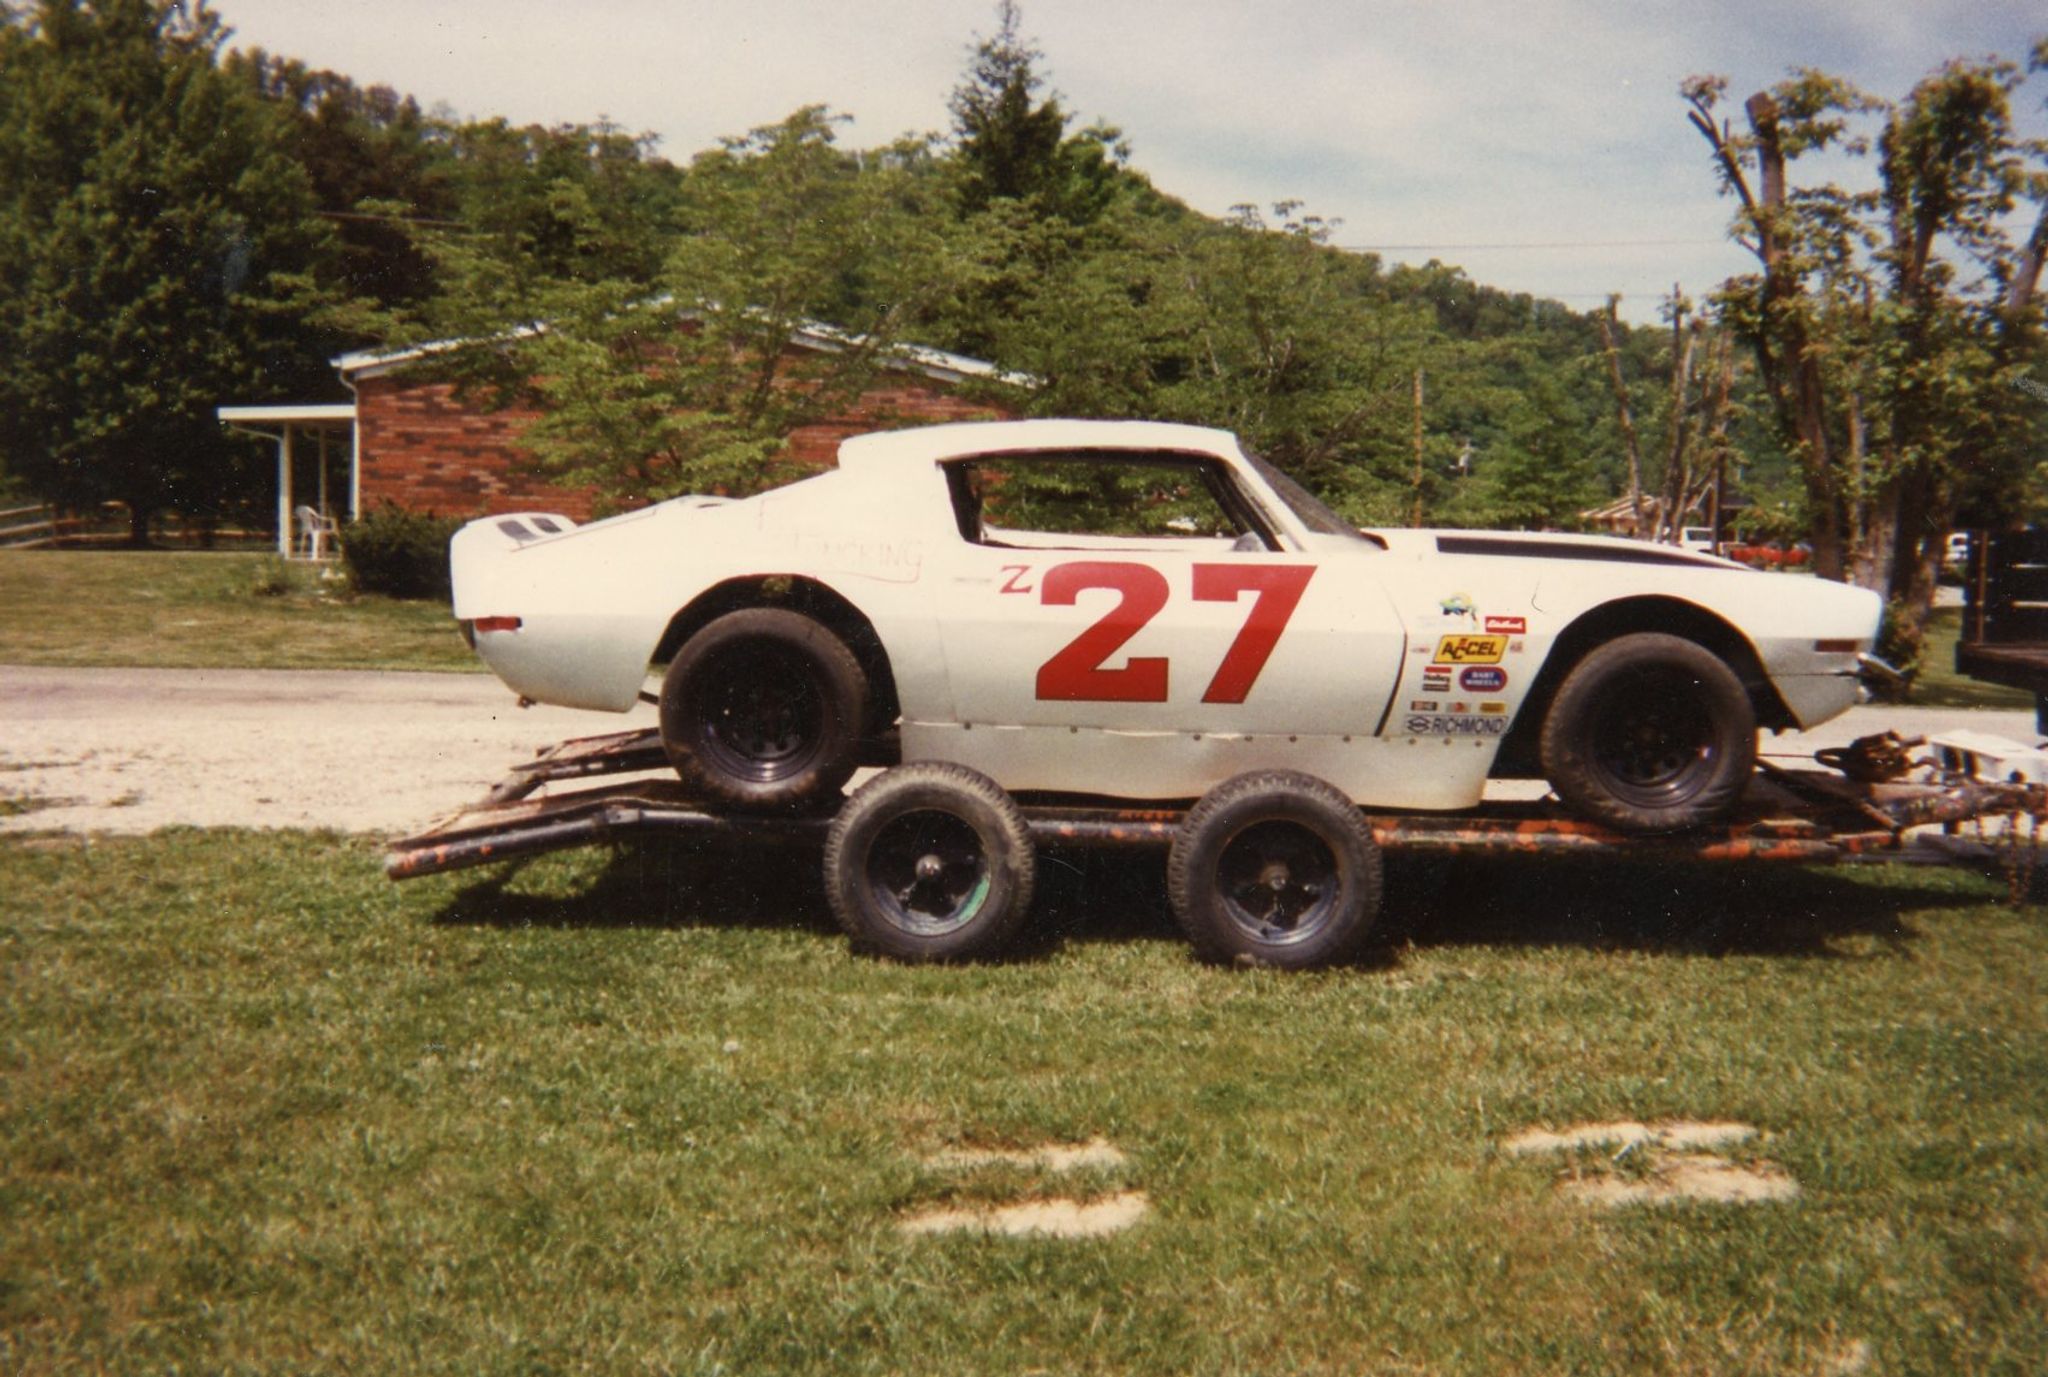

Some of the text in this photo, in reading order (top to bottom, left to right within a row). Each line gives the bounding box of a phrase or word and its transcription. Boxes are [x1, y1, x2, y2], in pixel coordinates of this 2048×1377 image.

[1035, 561, 1318, 704] 27
[1441, 639, 1498, 660] ACCEL
[1432, 717, 1504, 734] RICHMOND
